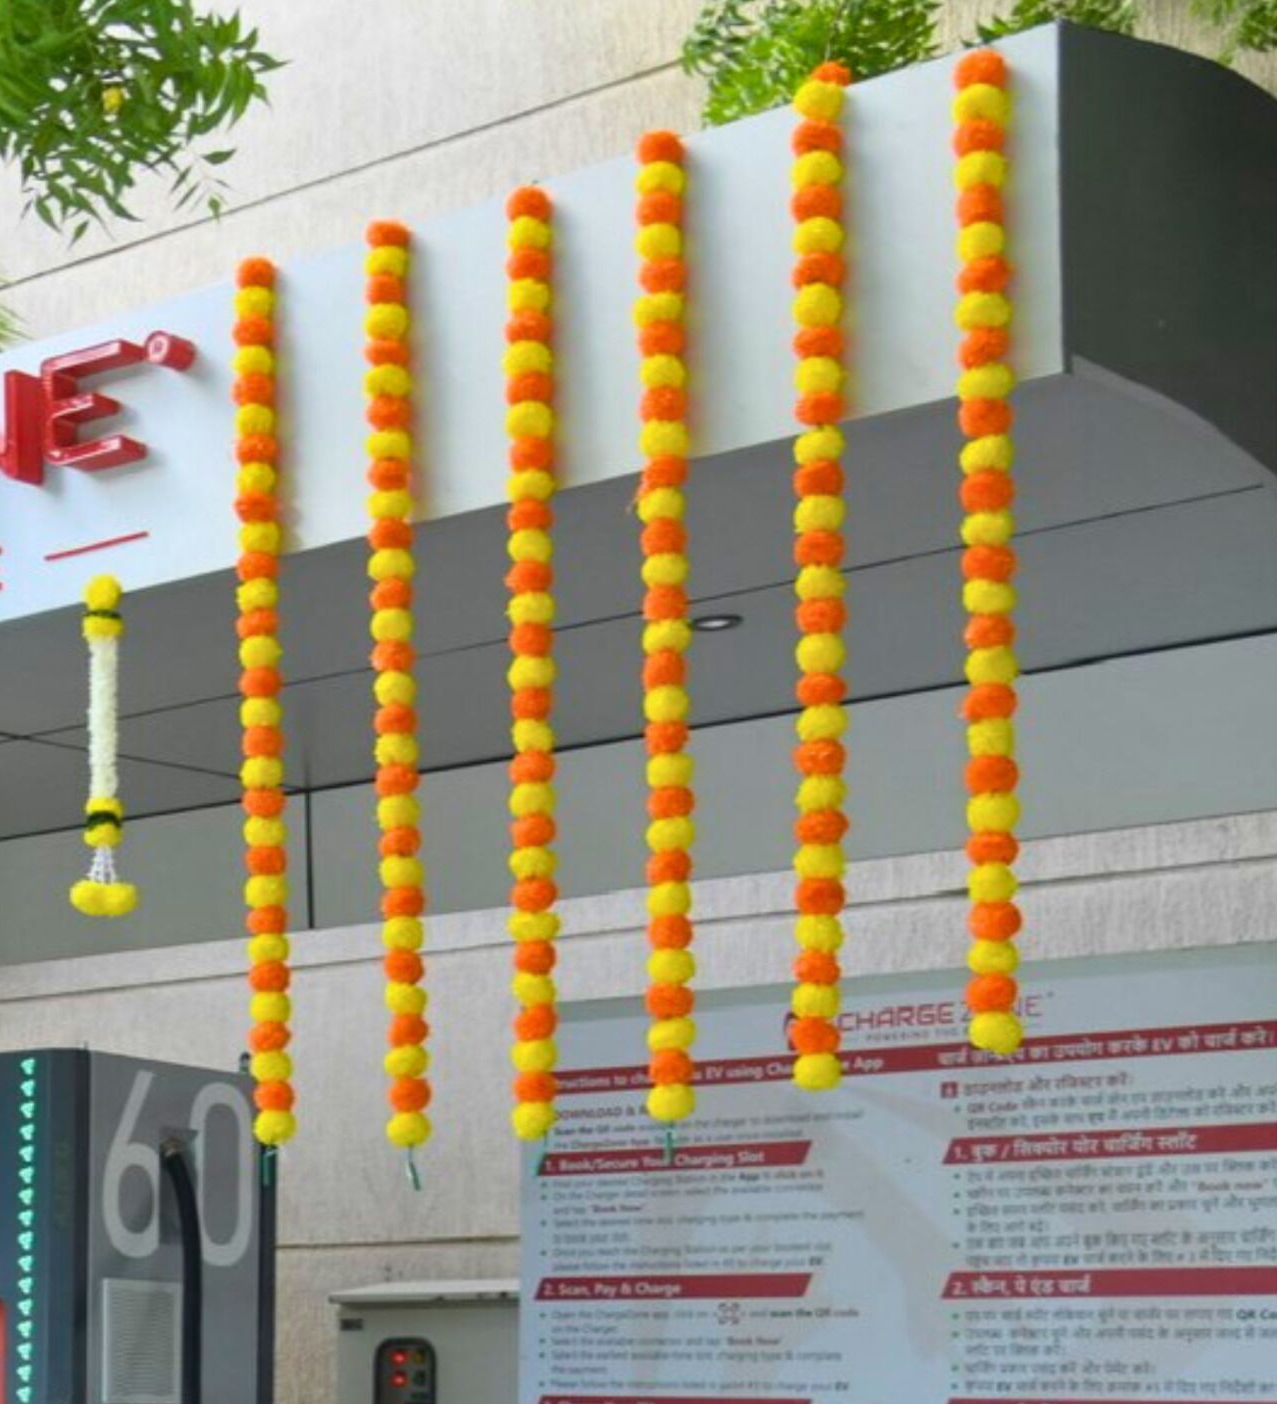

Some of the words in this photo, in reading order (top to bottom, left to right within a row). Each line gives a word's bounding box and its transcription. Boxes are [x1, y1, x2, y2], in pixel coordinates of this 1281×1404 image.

[838, 1002, 954, 1031] CHARGE
[706, 1067, 723, 1079] EV
[726, 1067, 763, 1079] using
[854, 1057, 884, 1072] App
[674, 1152, 734, 1166] Charging
[738, 1151, 765, 1163] Slot
[103, 1069, 253, 1267] 60
[544, 1284, 555, 1295] 2.
[594, 1283, 616, 1297] Pay
[636, 1282, 681, 1296] Charge
[952, 1282, 966, 1295] 2.
